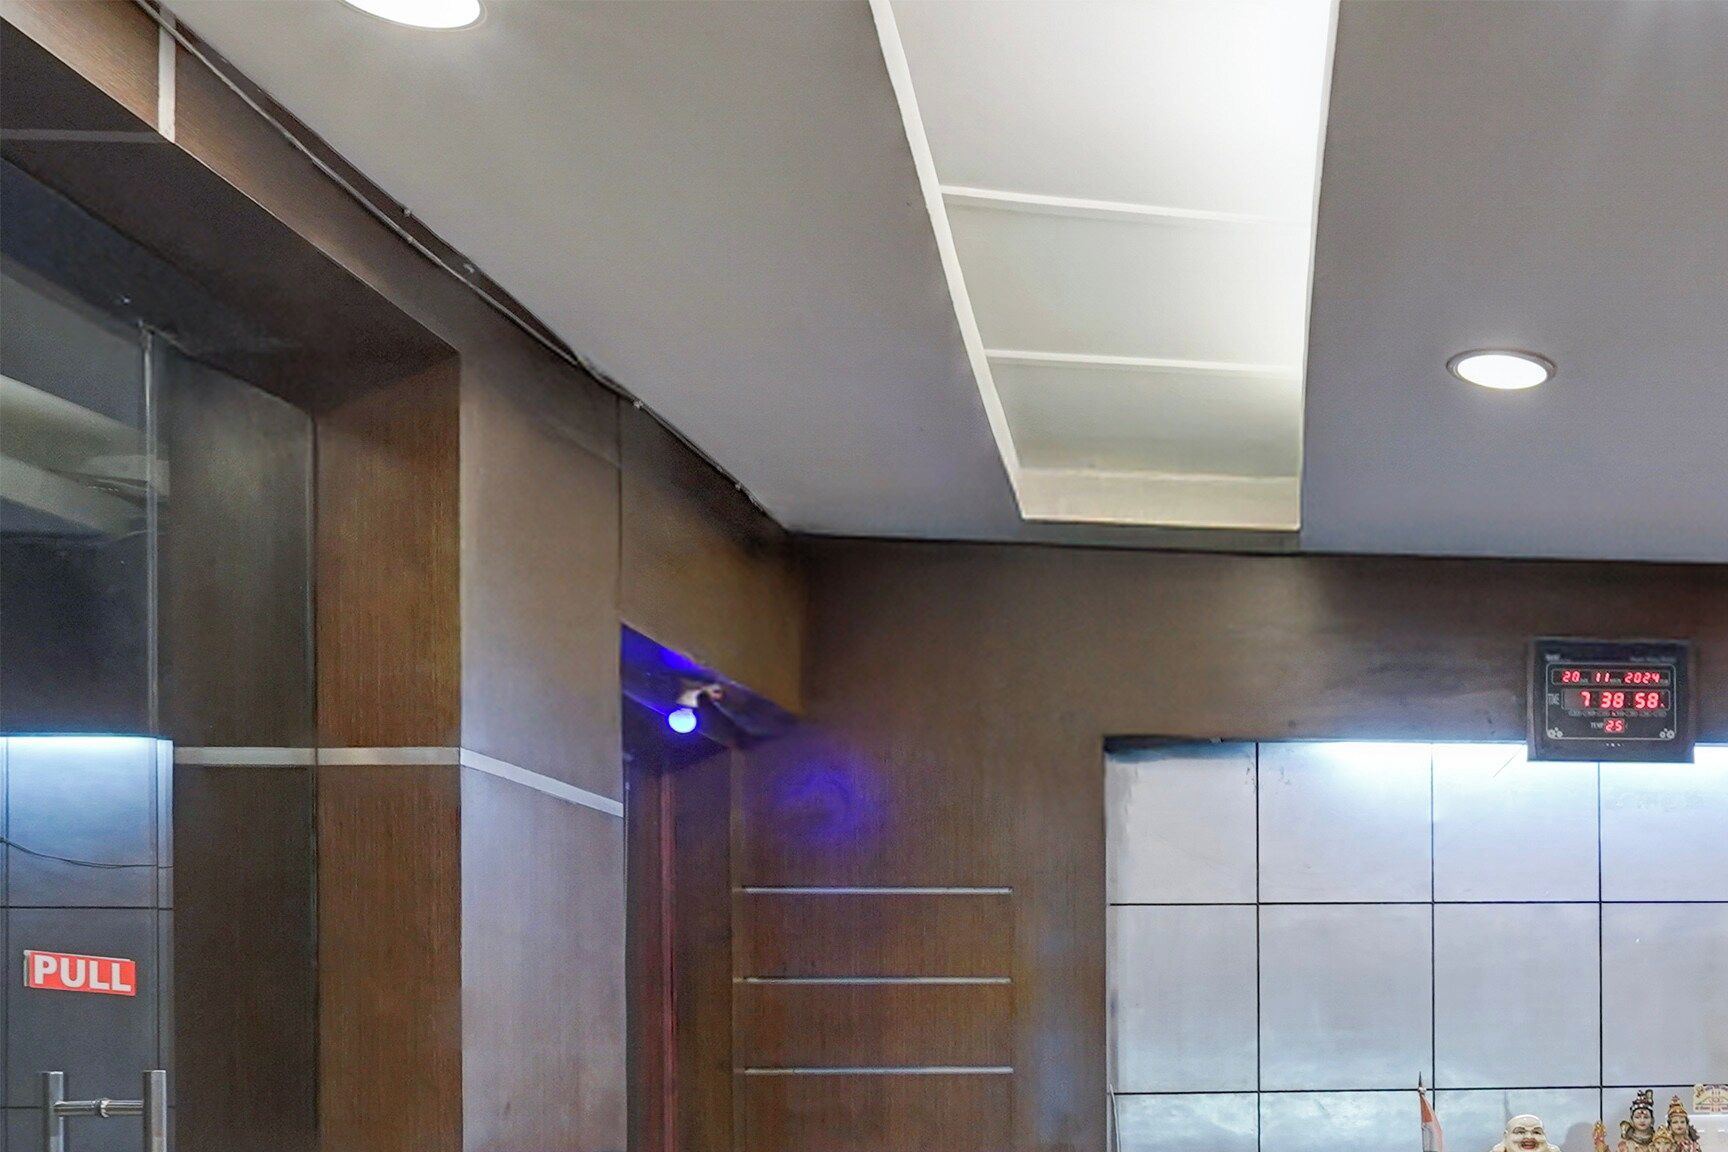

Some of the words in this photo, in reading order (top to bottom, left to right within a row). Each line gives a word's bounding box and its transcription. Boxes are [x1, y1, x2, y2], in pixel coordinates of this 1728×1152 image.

[1595, 672, 1610, 683] 11
[1624, 672, 1660, 684] 2024
[1601, 692, 1625, 709] 38
[1635, 692, 1660, 709] 58
[1605, 720, 1623, 732] 25
[34, 954, 132, 992] PULL
